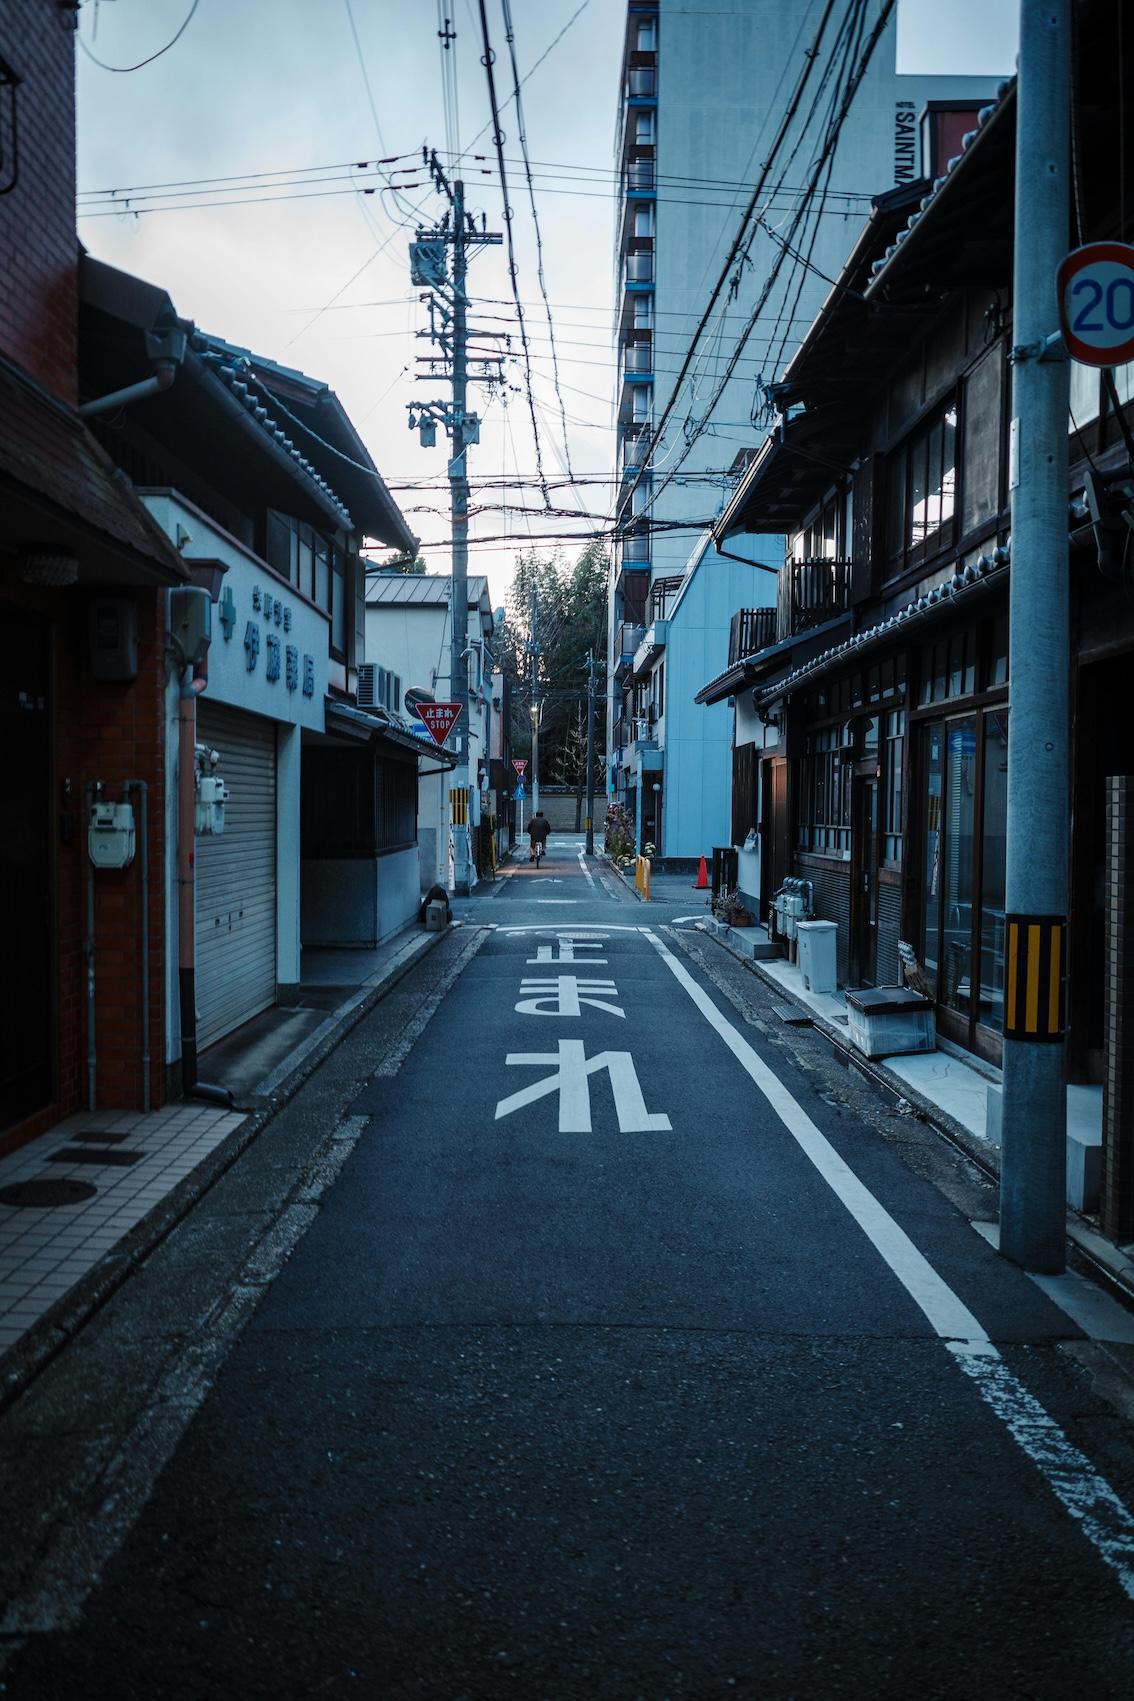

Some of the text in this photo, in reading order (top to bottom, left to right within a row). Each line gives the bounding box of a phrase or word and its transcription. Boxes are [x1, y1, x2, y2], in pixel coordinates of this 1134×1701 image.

[1072, 278, 1134, 331] 20
[426, 707, 454, 719] 止まれ
[430, 720, 450, 729] STOP
